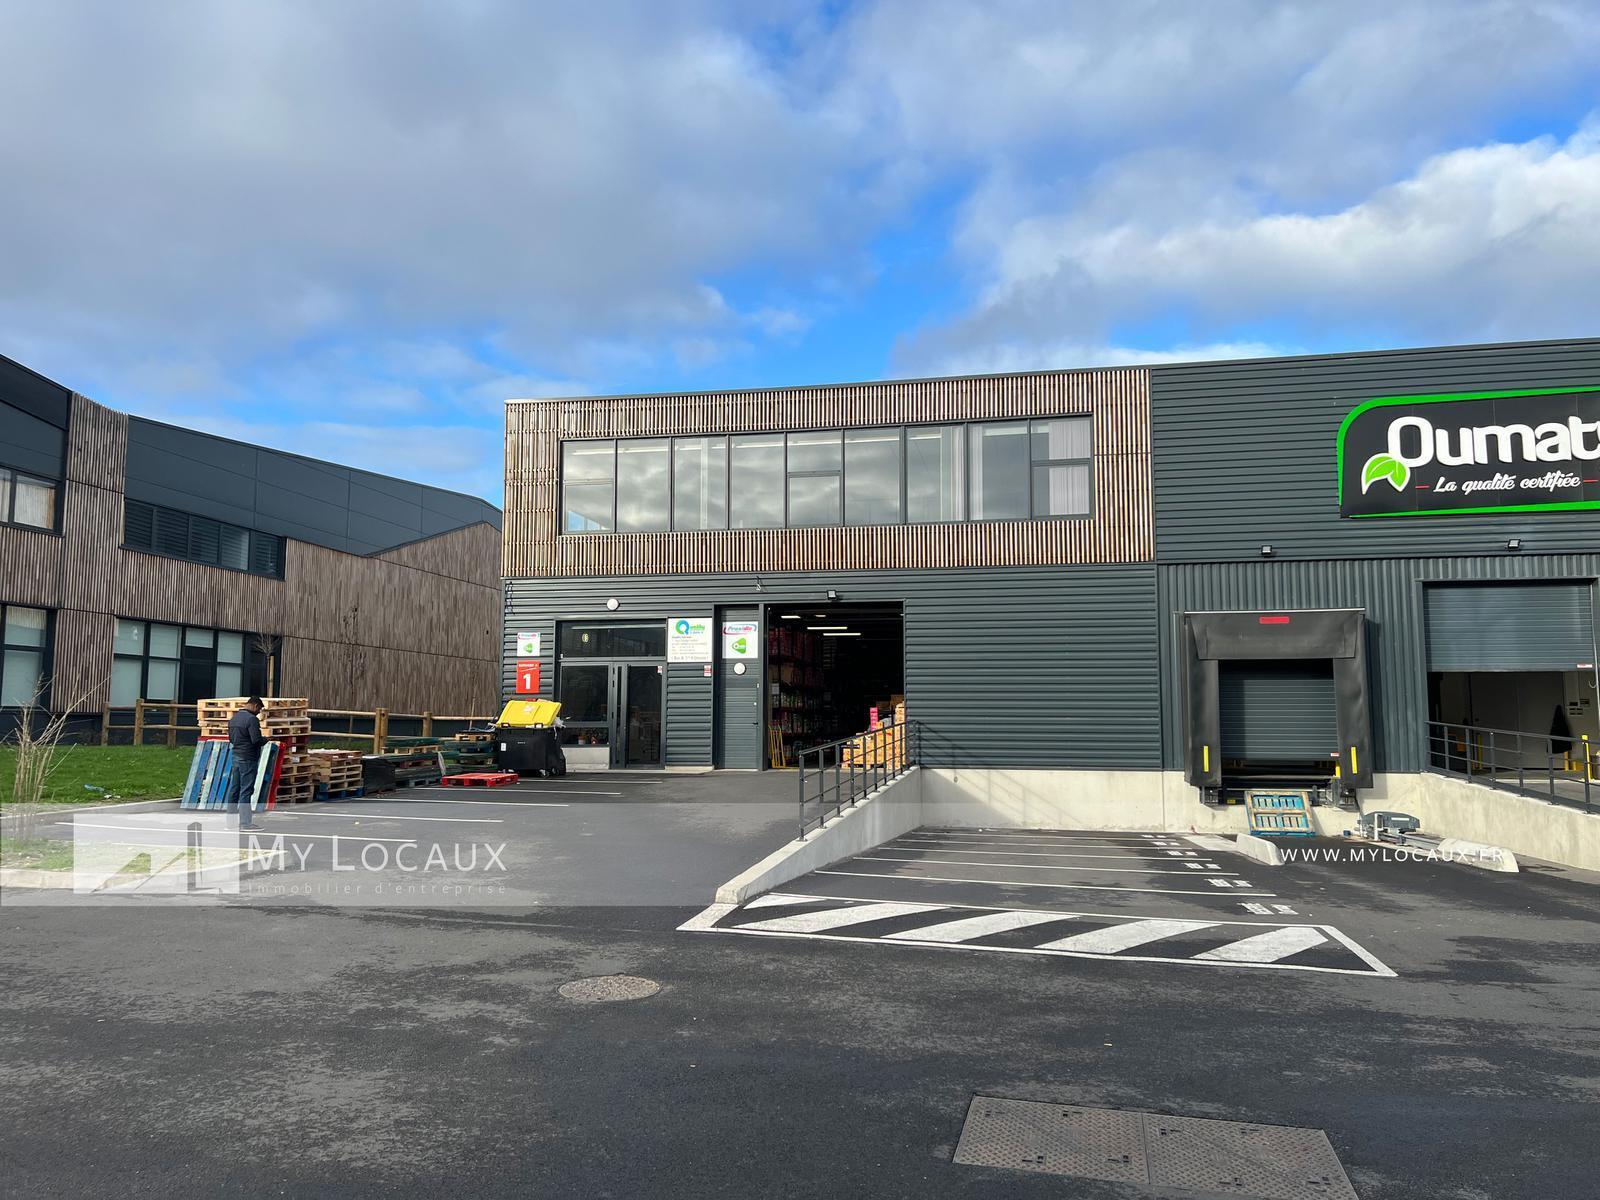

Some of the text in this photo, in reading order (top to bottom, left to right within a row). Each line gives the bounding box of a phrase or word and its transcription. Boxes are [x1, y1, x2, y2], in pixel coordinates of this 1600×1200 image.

[1387, 415, 1600, 468] Oumat
[1433, 469, 1581, 496] La qualité certifiée
[522, 673, 531, 690] 1
